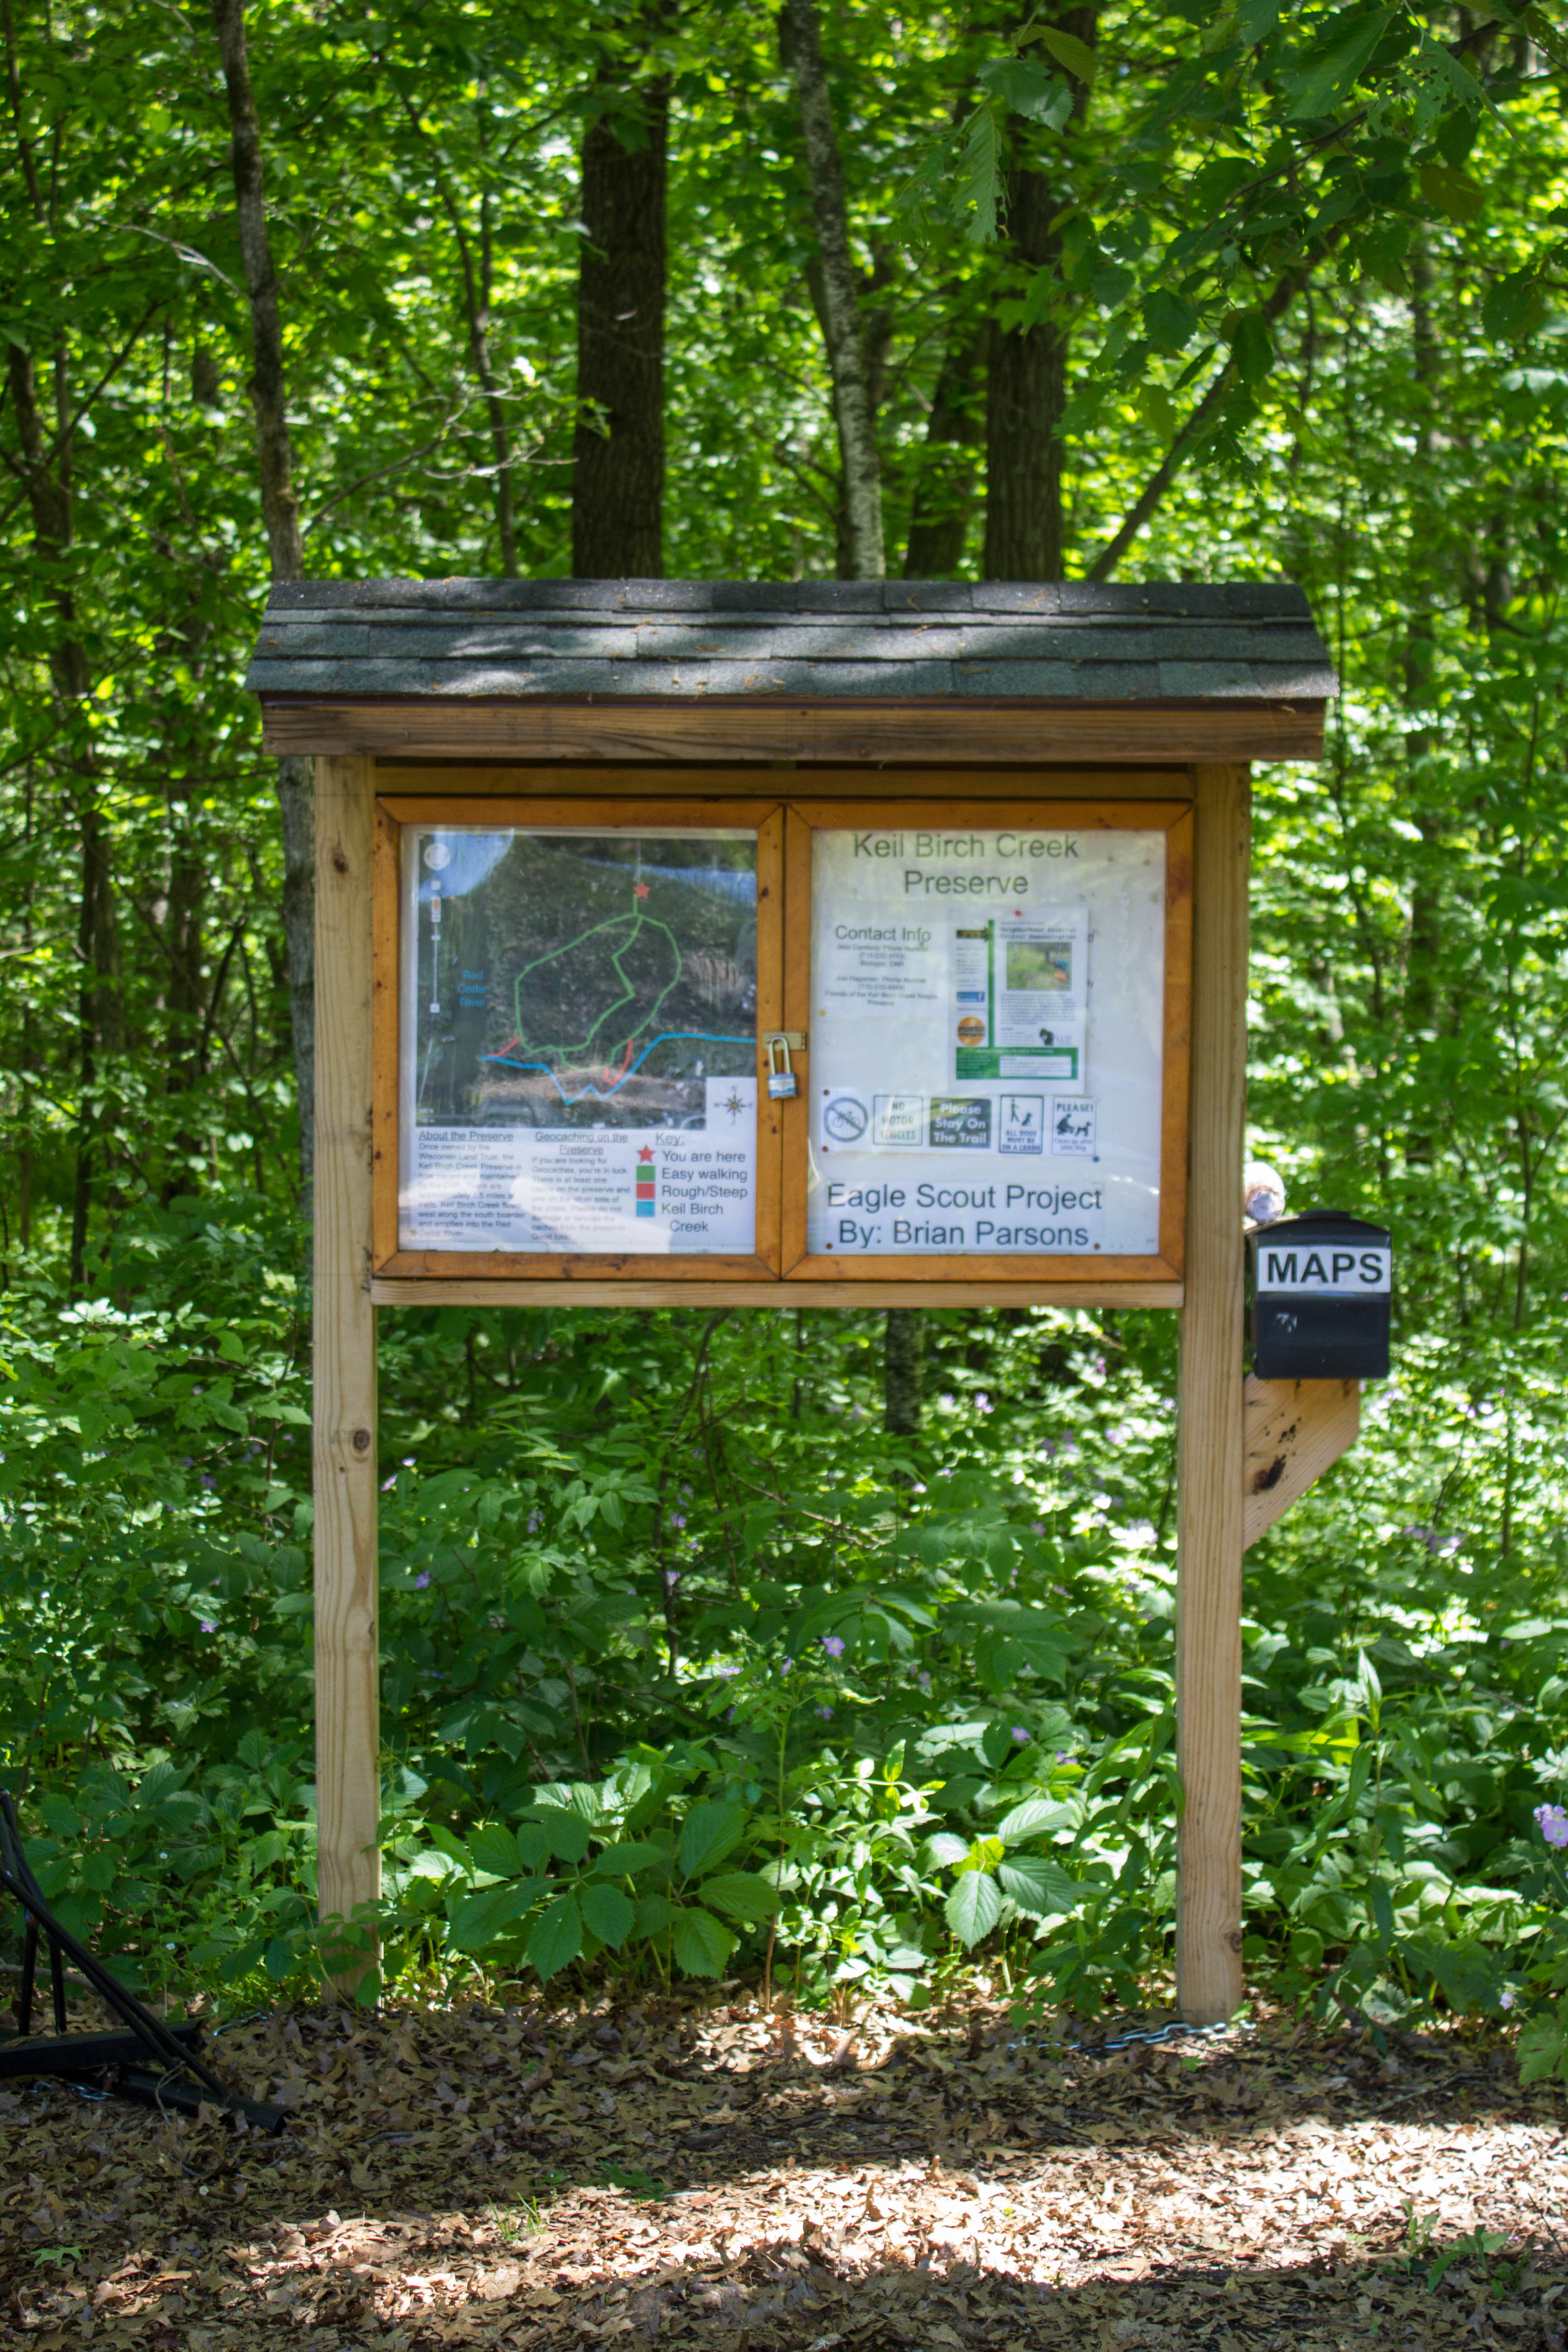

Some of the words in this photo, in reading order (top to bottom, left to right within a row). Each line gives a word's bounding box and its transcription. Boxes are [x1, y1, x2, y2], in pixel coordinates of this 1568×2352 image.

[853, 834, 904, 858] Keil
[916, 834, 985, 858] Birch
[996, 833, 1079, 858] Creek
[904, 870, 1029, 894] Preserve
[835, 925, 897, 941] Contact
[902, 926, 931, 942] Info
[892, 1102, 905, 1110] NO
[940, 1102, 981, 1114] Please
[1057, 1103, 1093, 1112] PLEASE!
[882, 1116, 914, 1125] MOTOR
[935, 1117, 963, 1131] Stay
[967, 1119, 985, 1129] On
[419, 1131, 448, 1141] About
[451, 1132, 466, 1141] the
[470, 1132, 514, 1142] Preserve
[535, 1132, 594, 1143] Geocaching
[598, 1134, 609, 1142] on
[613, 1133, 628, 1143] the
[656, 1132, 685, 1147] Key:
[881, 1130, 916, 1140] VEHICLES
[934, 1132, 955, 1143] The
[960, 1132, 986, 1143] Trail
[559, 1145, 603, 1155] Preserve
[662, 1150, 686, 1161] You
[691, 1153, 712, 1162] are
[716, 1151, 745, 1162] here
[662, 1167, 694, 1182] Easy
[699, 1168, 747, 1183] walking
[662, 1185, 748, 1200] Rough/Steep
[829, 1183, 906, 1213] Eagle
[916, 1184, 996, 1207] Scout
[1007, 1185, 1102, 1215] Project
[662, 1203, 686, 1215] Keil
[690, 1203, 723, 1215] Birch
[670, 1220, 709, 1232] Creek
[840, 1220, 882, 1248] By:
[894, 1221, 965, 1244] Brian
[976, 1221, 1088, 1245] Parsons
[1268, 1253, 1383, 1284] MAPS
